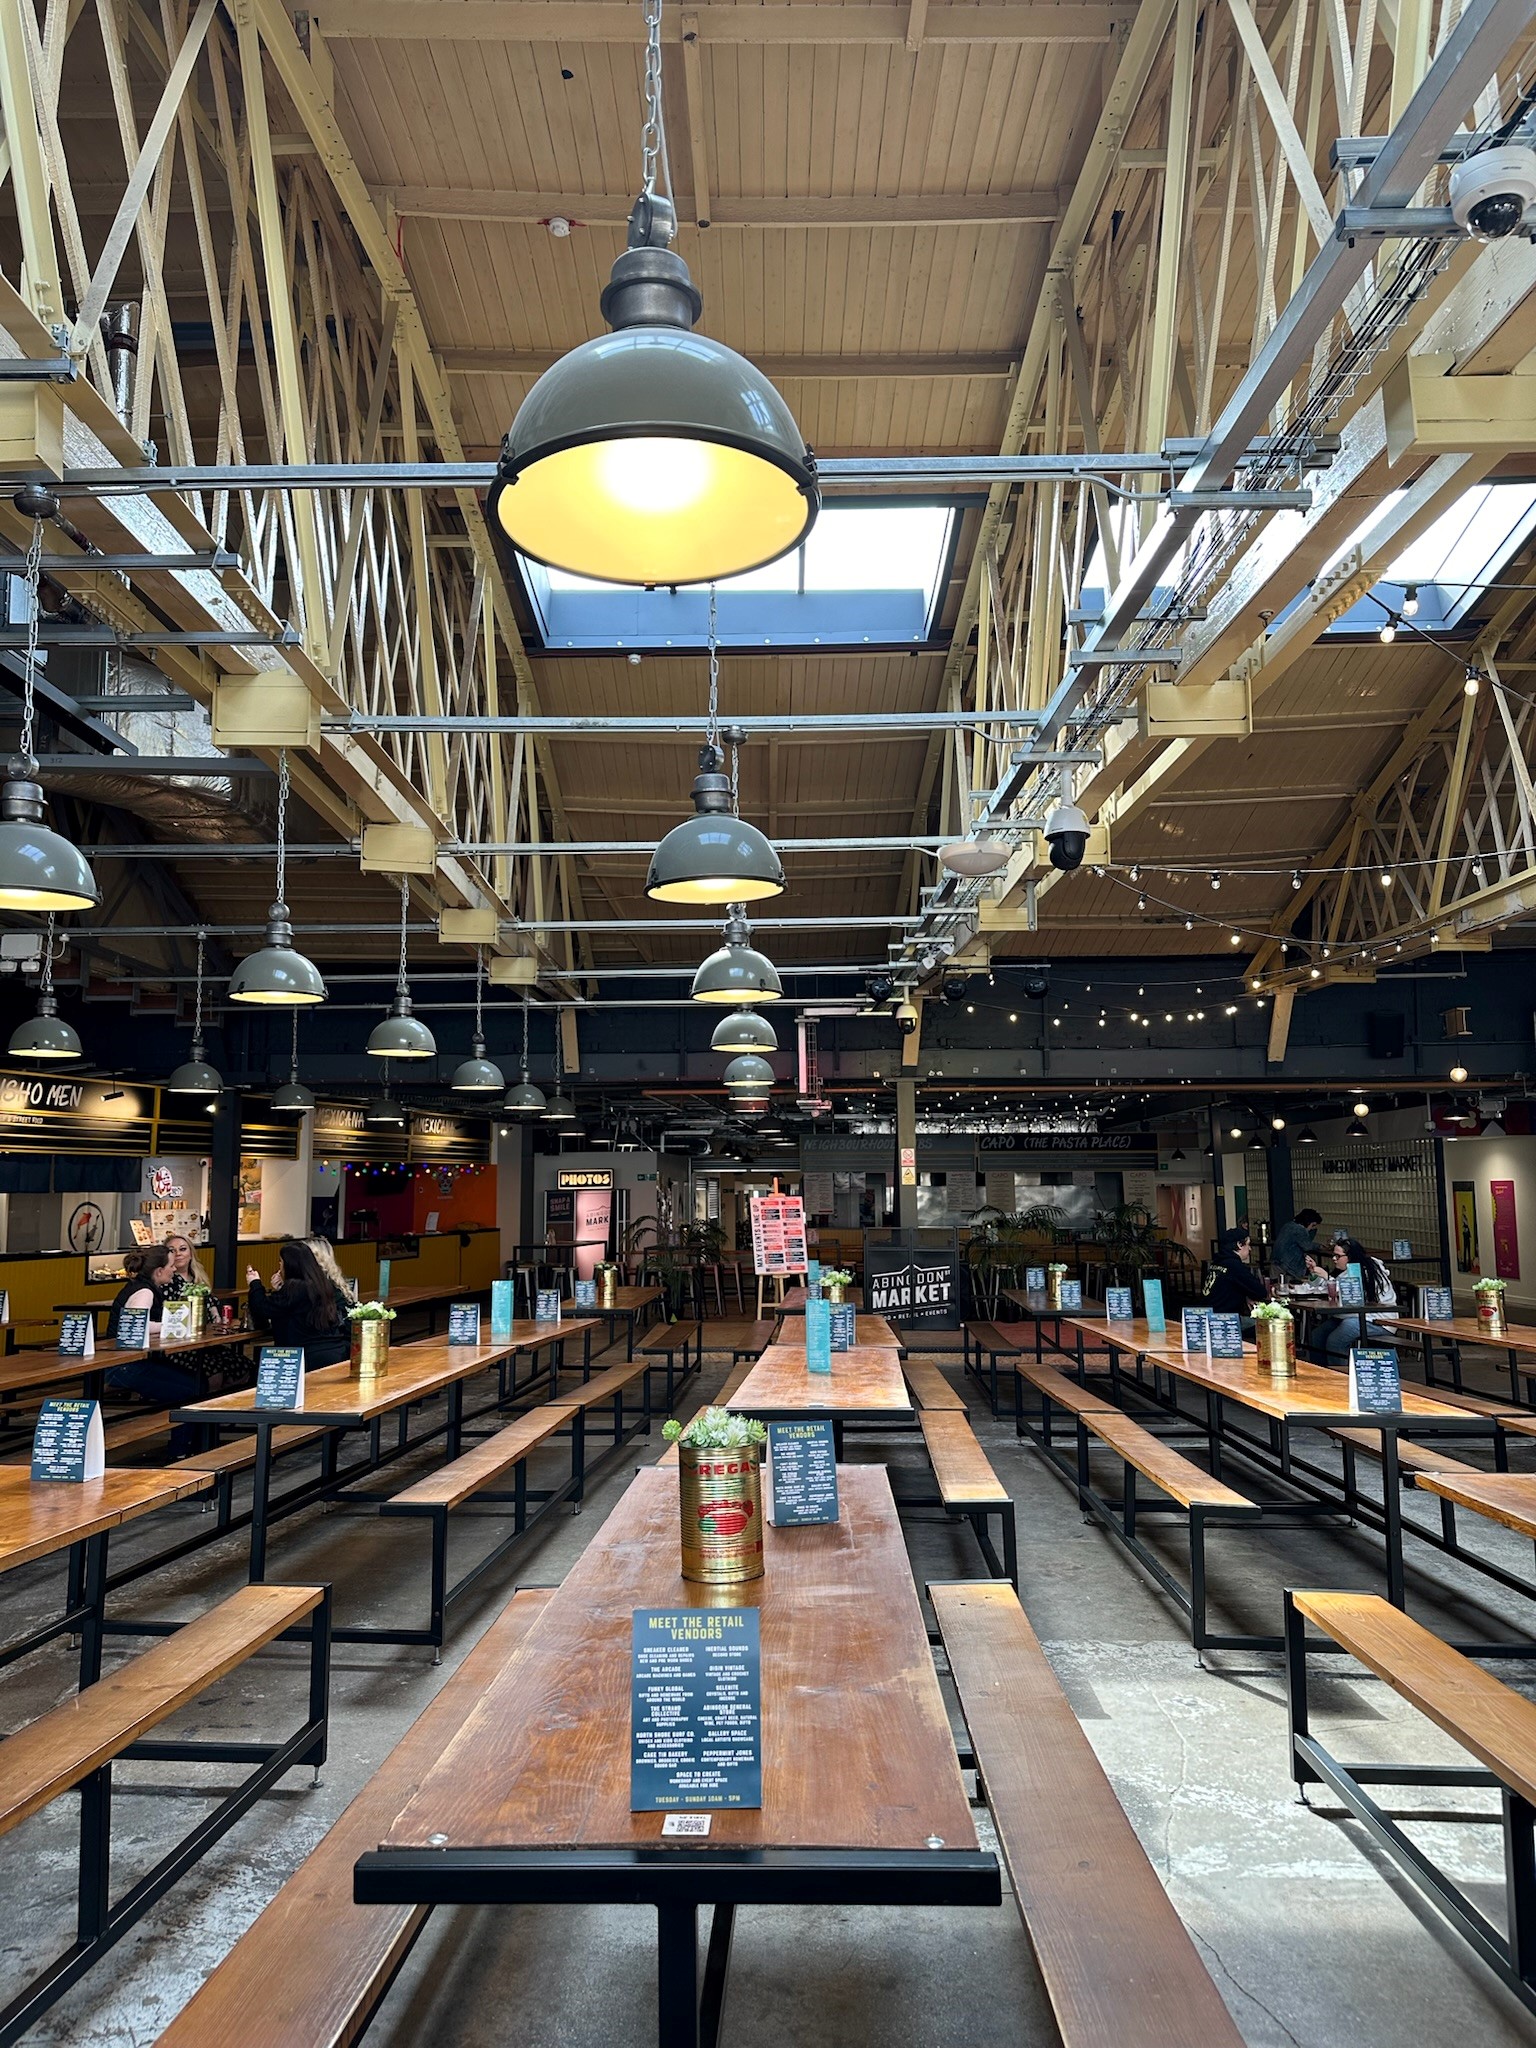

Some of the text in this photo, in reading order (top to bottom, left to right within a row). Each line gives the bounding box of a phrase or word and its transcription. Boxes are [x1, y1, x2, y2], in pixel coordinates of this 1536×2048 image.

[0, 1078, 83, 1107] SHO MEN
[981, 1136, 1131, 1149] CAPO (THE PASTA PLACE)
[1322, 1155, 1422, 1173] ABINGDON STREET MARKET
[561, 1174, 610, 1185] PHOTOS
[550, 1203, 570, 1212] SMILE
[753, 1204, 760, 1212] UP
[586, 1216, 608, 1226] MARK
[754, 1229, 762, 1251] EVENTS
[873, 1282, 951, 1309] MARKET
[649, 1616, 744, 1629] MEET THE RETAIL
[671, 1628, 722, 1640] VENDORS
